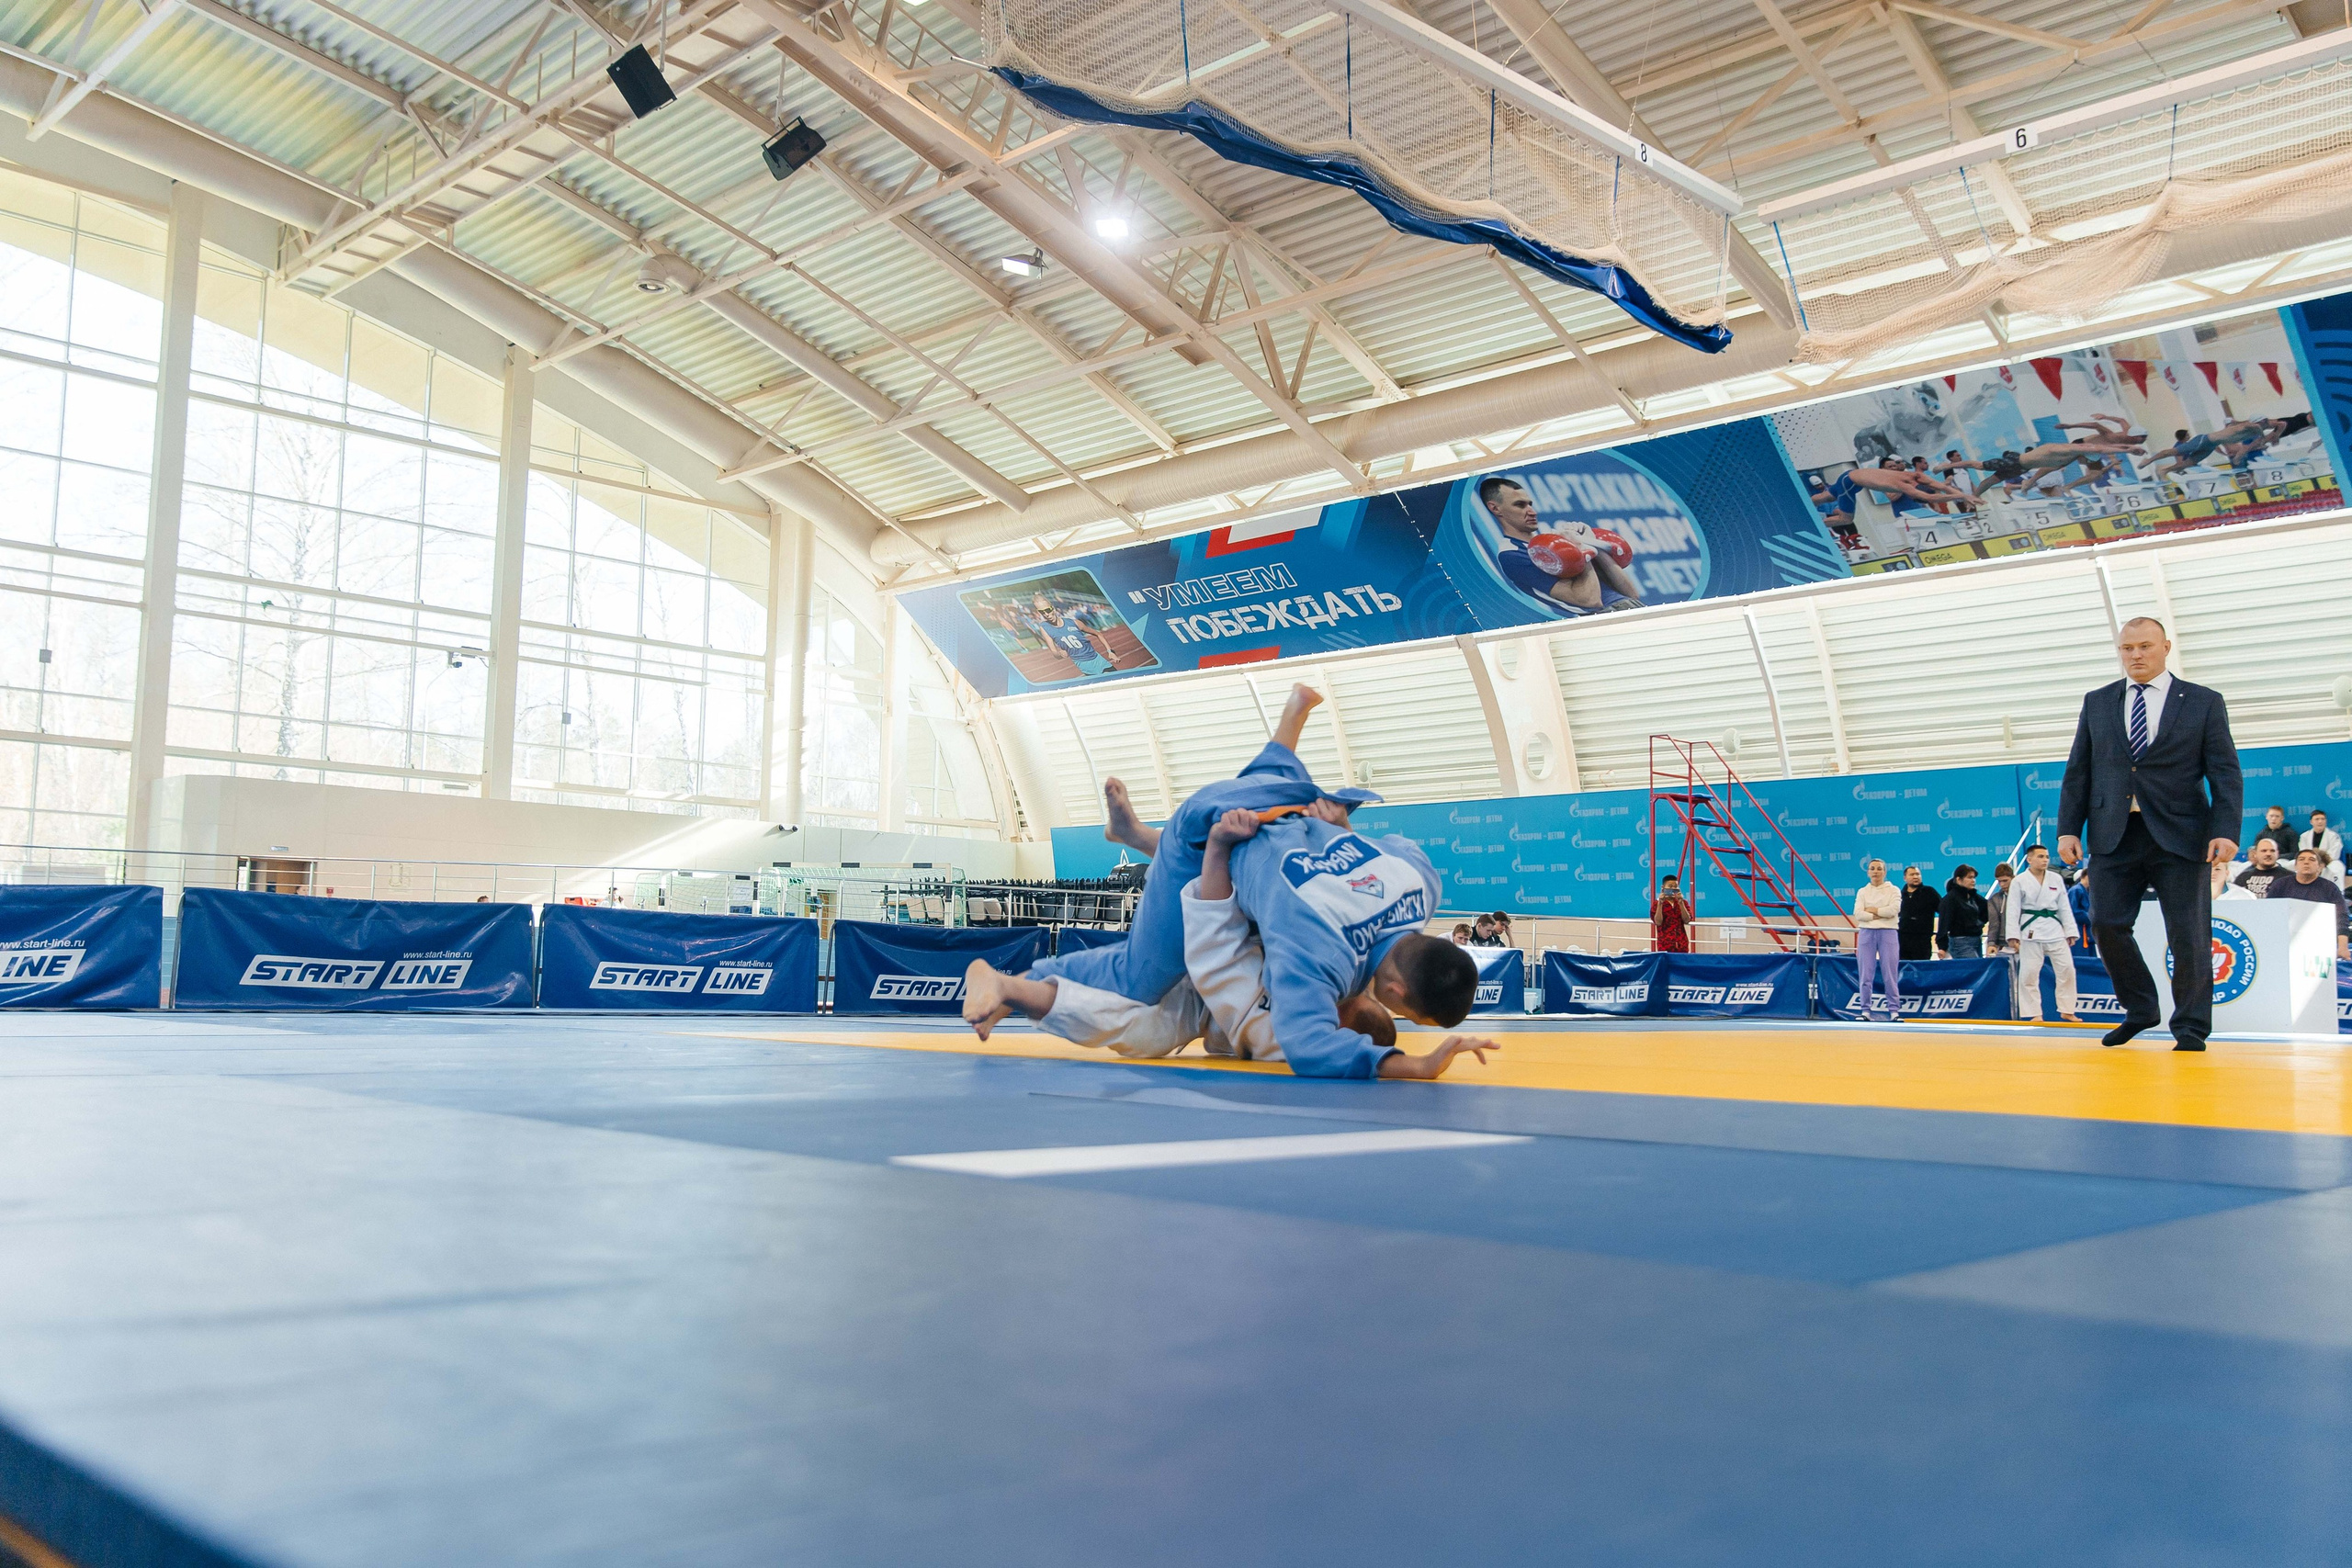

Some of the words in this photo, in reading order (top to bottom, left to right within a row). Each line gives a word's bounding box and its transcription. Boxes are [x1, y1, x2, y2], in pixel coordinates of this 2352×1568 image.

[2016, 128, 2027, 148] 6
[1640, 142, 1647, 163] 8
[2035, 511, 2050, 525] 5
[1925, 531, 1939, 545] 4
[1924, 553, 1953, 565] OMEGA
[1165, 584, 1403, 644] ПОБЕЖДАТЬ
[1060, 635, 1083, 649] 16
[2245, 875, 2275, 885] JUDO
[402, 950, 473, 959] www.start-line.ru
[1, 955, 74, 977] INE
[719, 959, 773, 968] www.start-line.ru
[2239, 939, 2255, 986] РОССИИ
[250, 960, 376, 985] START
[389, 964, 463, 985] LINE
[597, 966, 698, 988] START
[709, 972, 765, 990] LINE
[876, 978, 958, 997] START
[1475, 988, 1499, 1001] LINE
[1573, 988, 1612, 1000] START
[1618, 987, 1645, 999] LINE
[1730, 990, 1768, 1001] LINE
[1928, 998, 1967, 1010] LINE
